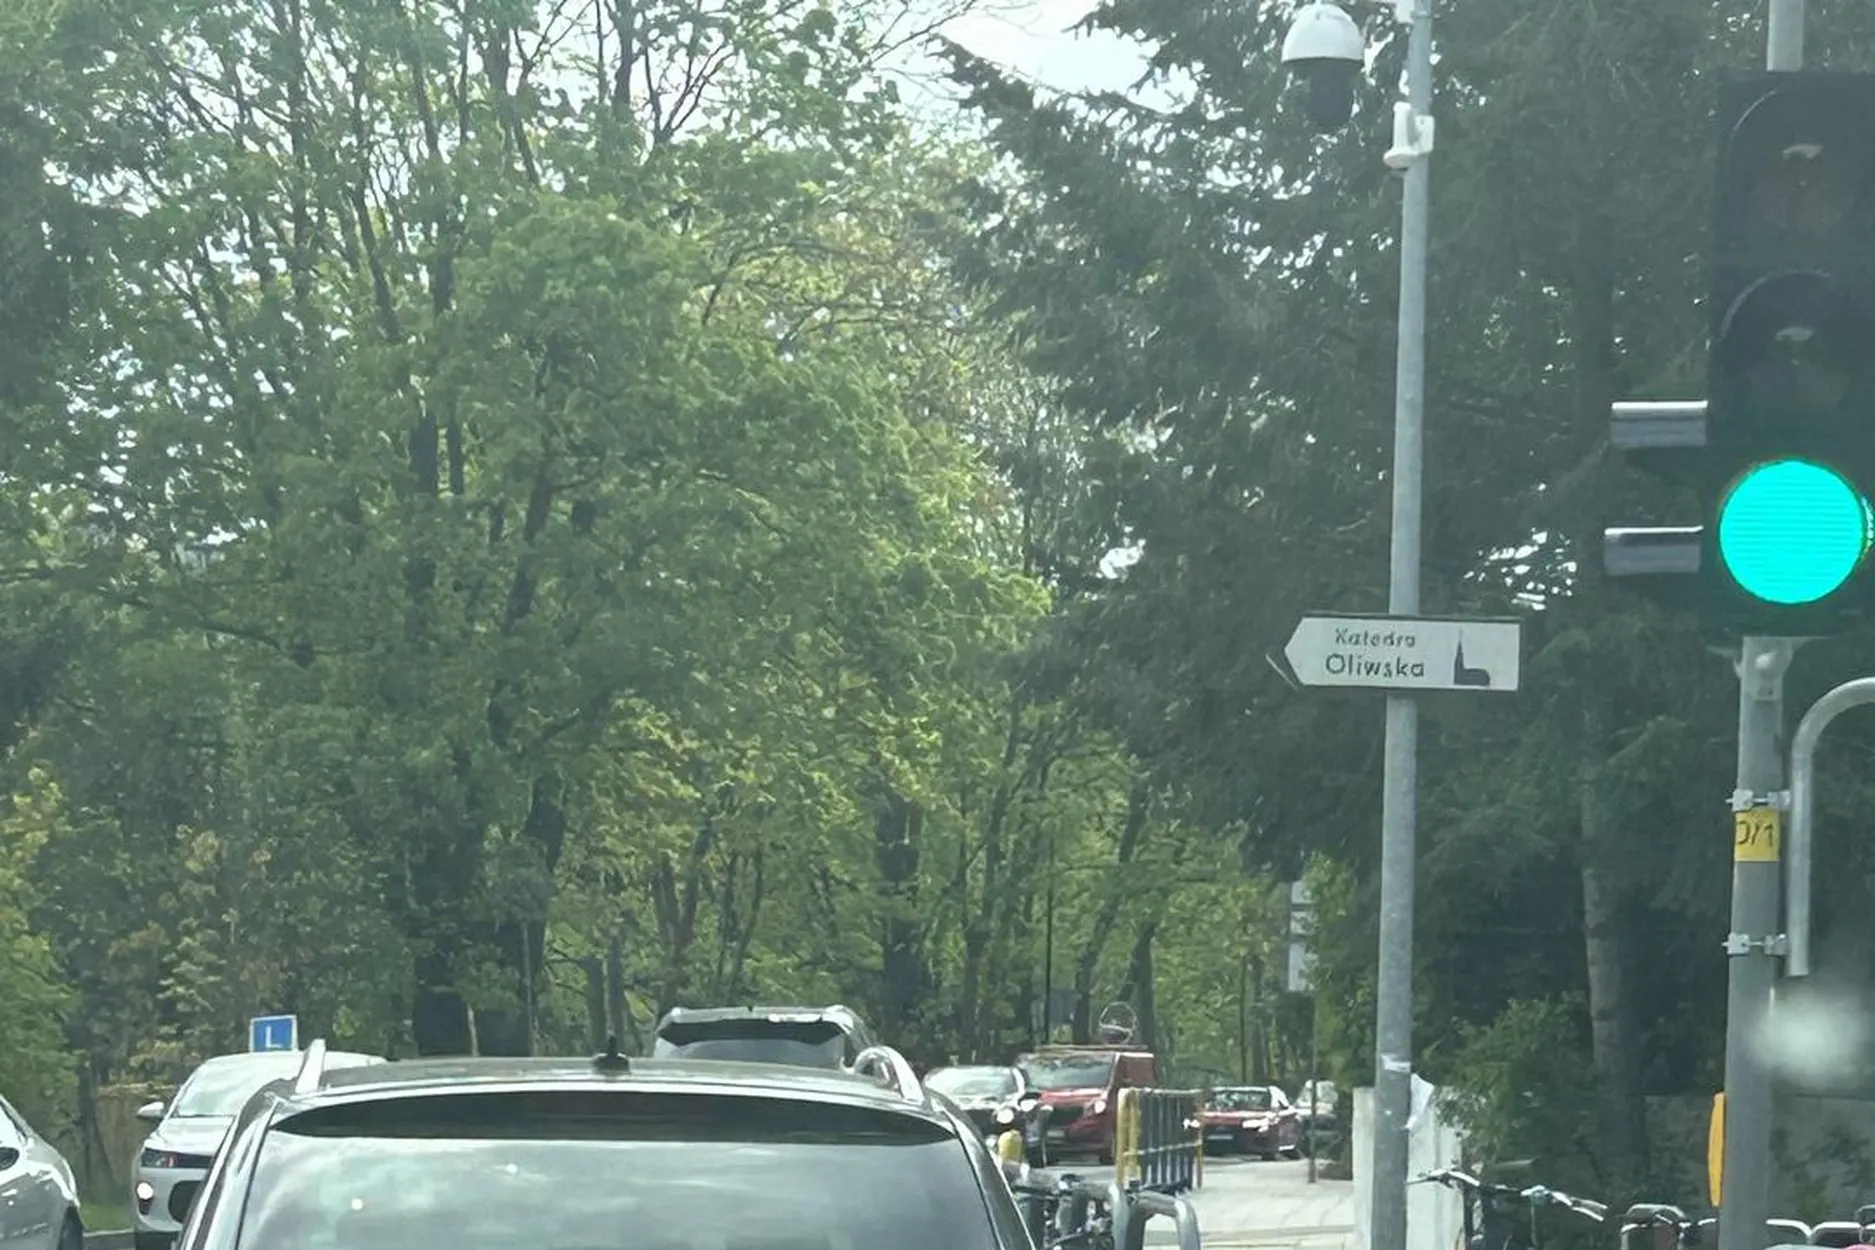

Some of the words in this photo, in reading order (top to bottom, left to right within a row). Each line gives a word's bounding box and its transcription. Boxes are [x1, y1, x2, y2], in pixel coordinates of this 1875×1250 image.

[1335, 627, 1416, 649] Katedra
[1325, 653, 1425, 678] Oliwska
[265, 1026, 284, 1049] L
